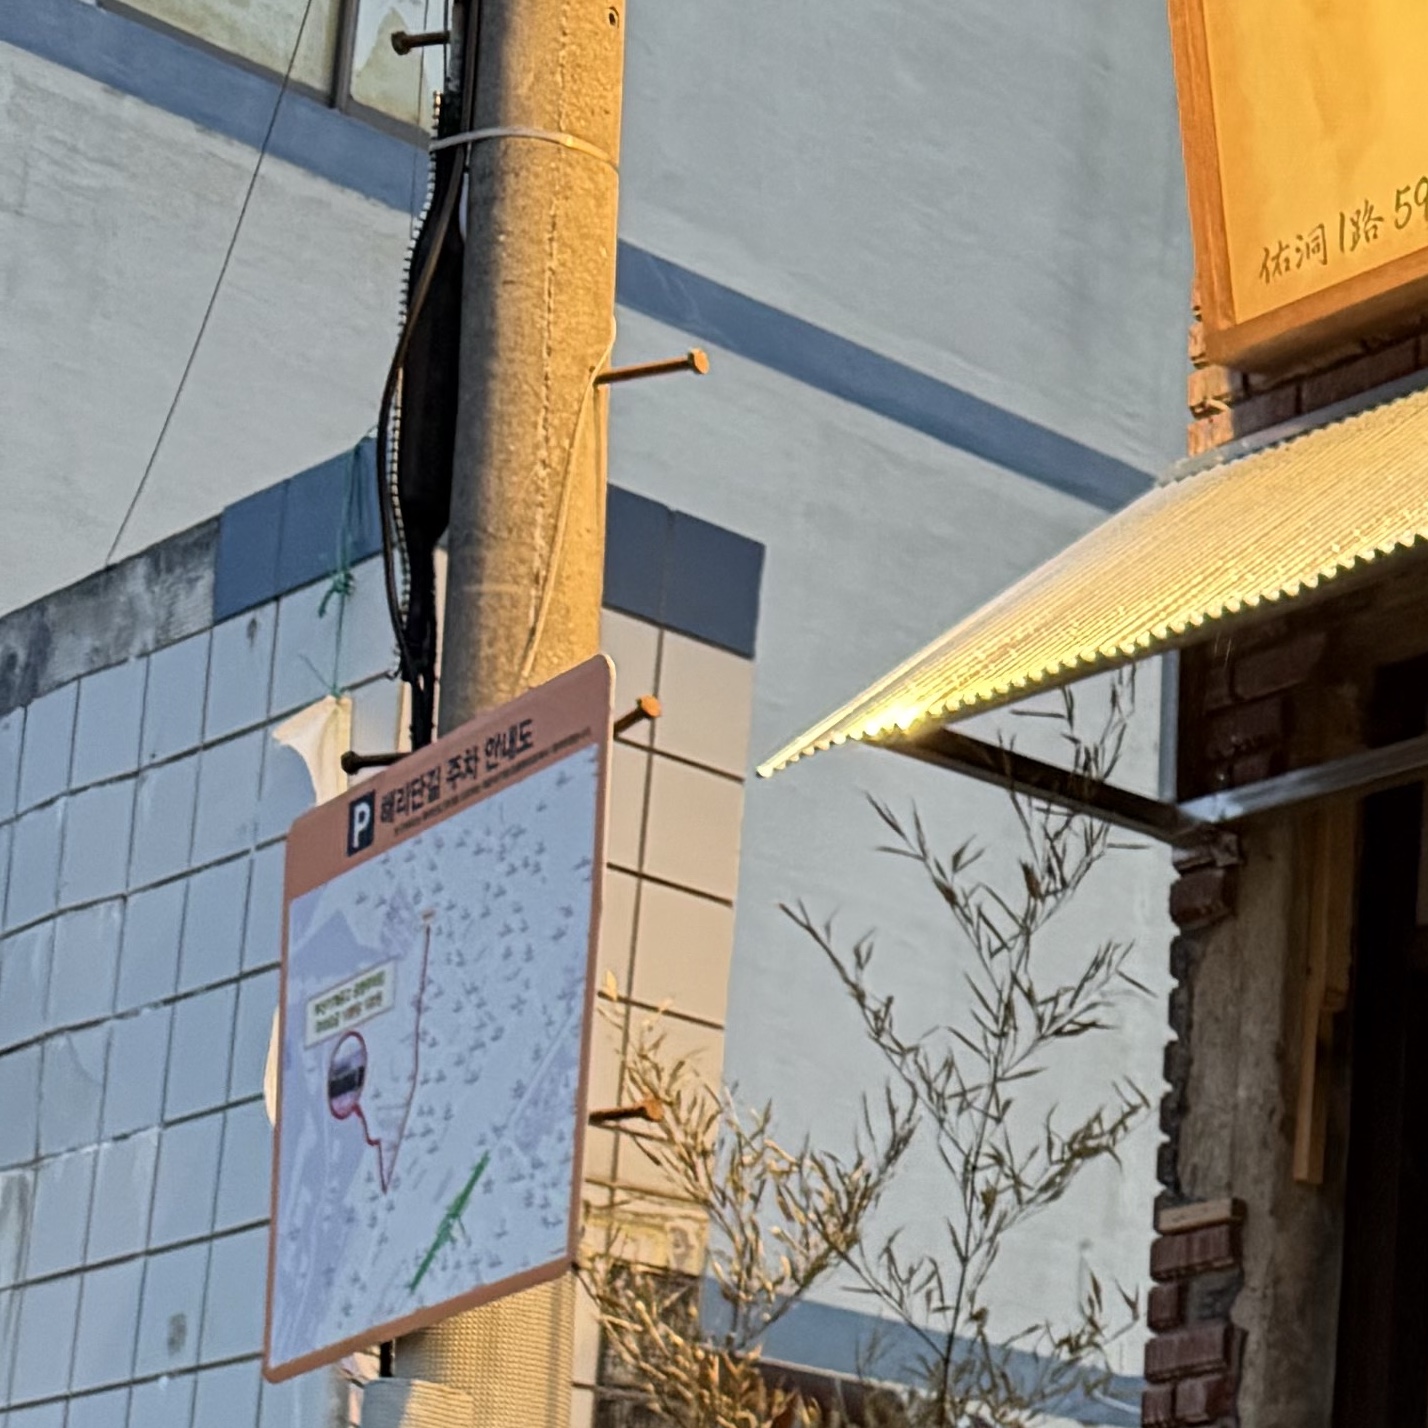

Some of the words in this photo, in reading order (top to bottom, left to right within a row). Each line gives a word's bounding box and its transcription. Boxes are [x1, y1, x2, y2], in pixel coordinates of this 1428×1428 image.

[446, 746, 480, 789] 주차
[484, 718, 533, 771] 안내도
[353, 802, 370, 849] P
